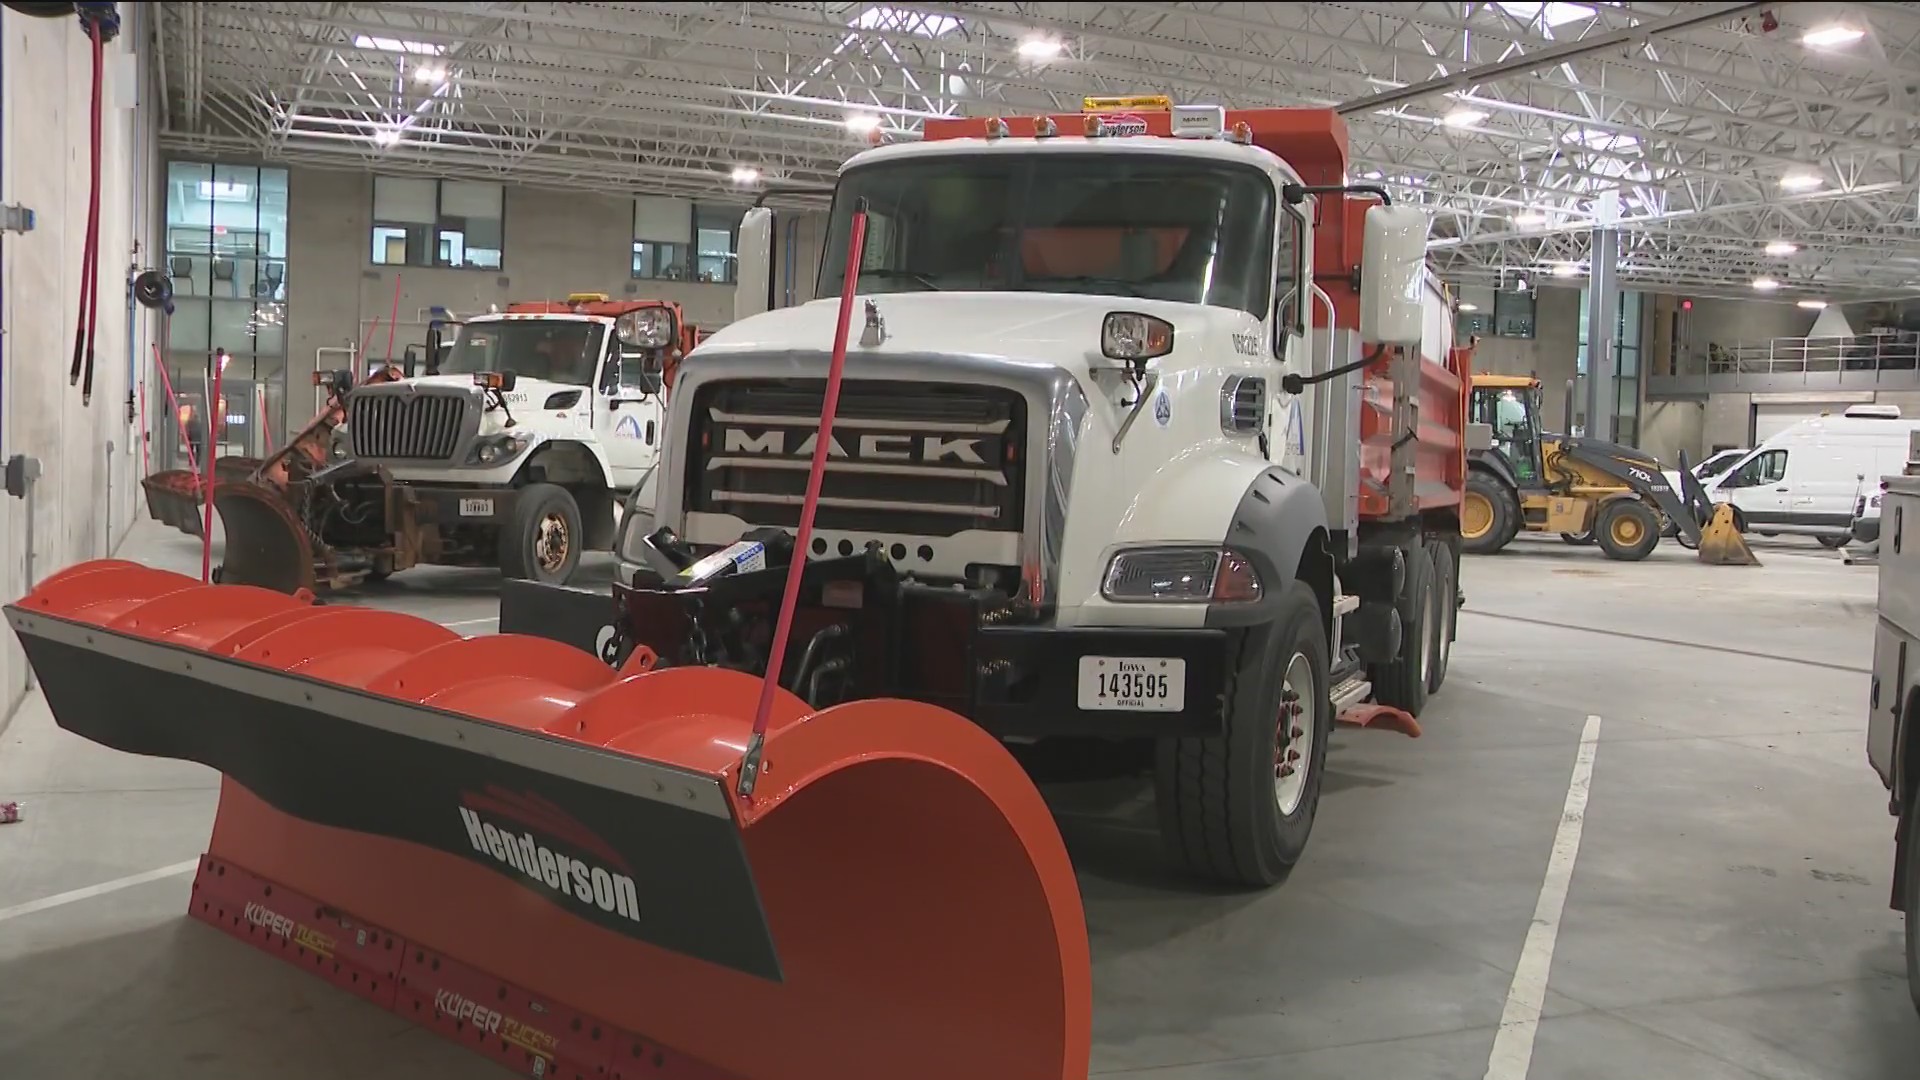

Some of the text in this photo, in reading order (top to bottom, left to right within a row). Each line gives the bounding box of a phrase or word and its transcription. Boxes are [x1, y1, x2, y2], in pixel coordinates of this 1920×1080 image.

[725, 429, 986, 464] MACK
[1098, 673, 1168, 698] 143595
[458, 805, 641, 922] Henderson
[243, 901, 294, 938] KÜPER
[434, 988, 502, 1034] KÜPER
